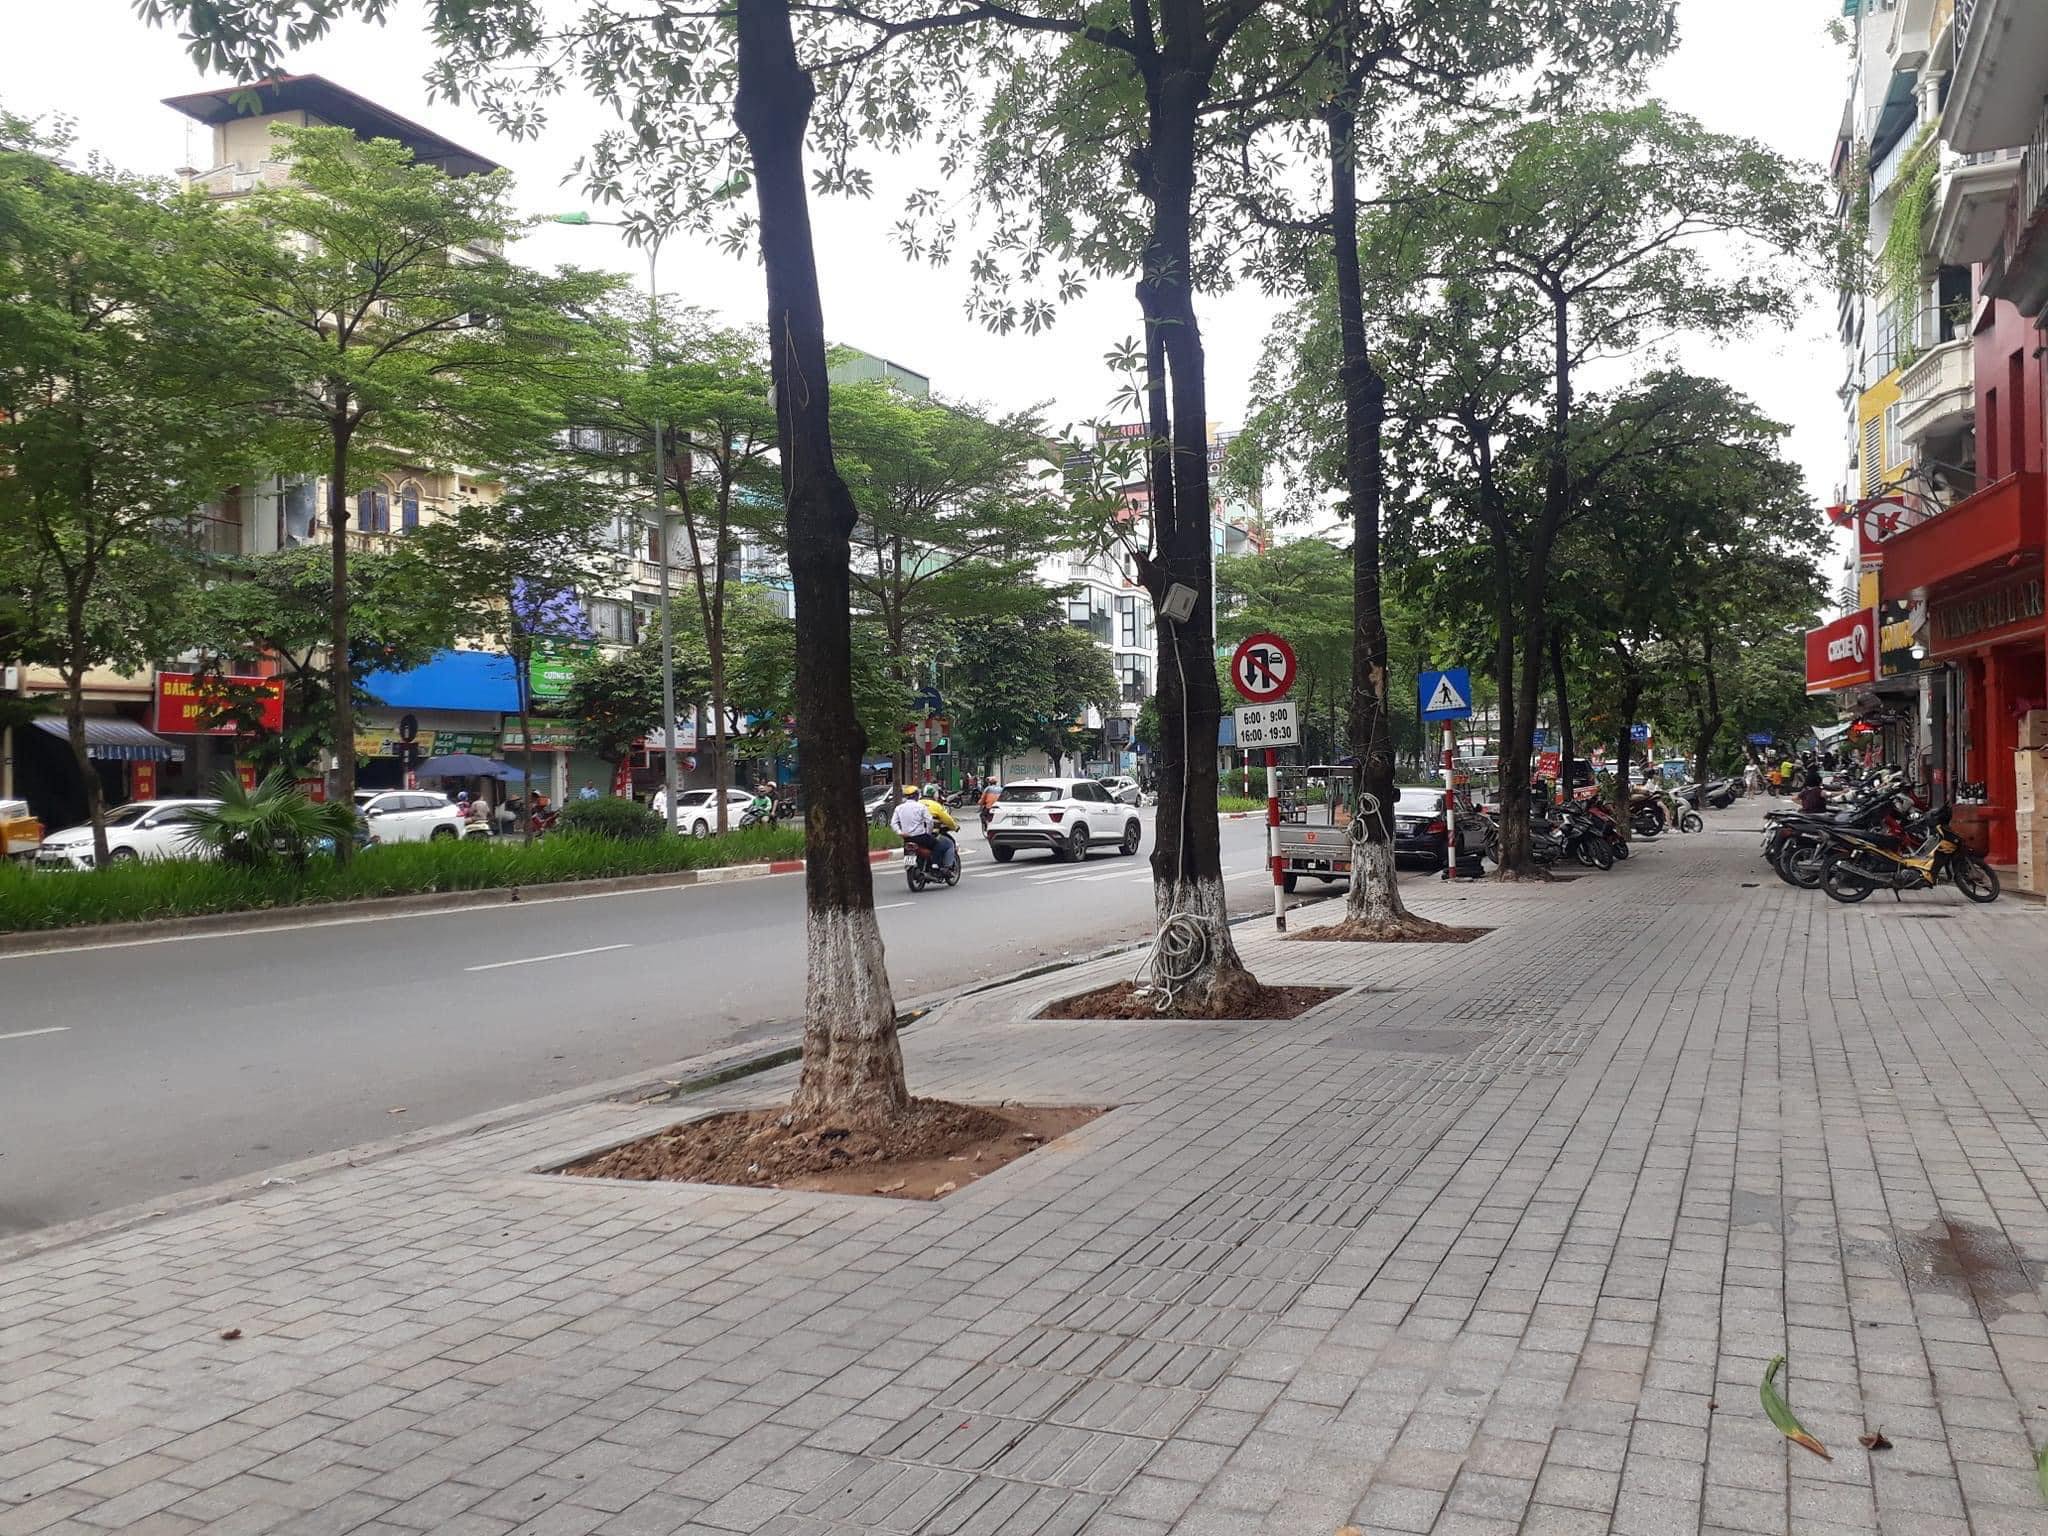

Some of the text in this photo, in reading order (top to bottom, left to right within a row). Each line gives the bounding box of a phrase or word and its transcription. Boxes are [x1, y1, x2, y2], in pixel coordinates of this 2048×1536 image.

[1243, 711, 1261, 725] 6:00
[1269, 708, 1288, 722] 9:00
[1240, 729, 1262, 742] 16:00
[1269, 726, 1292, 740] 19:30
